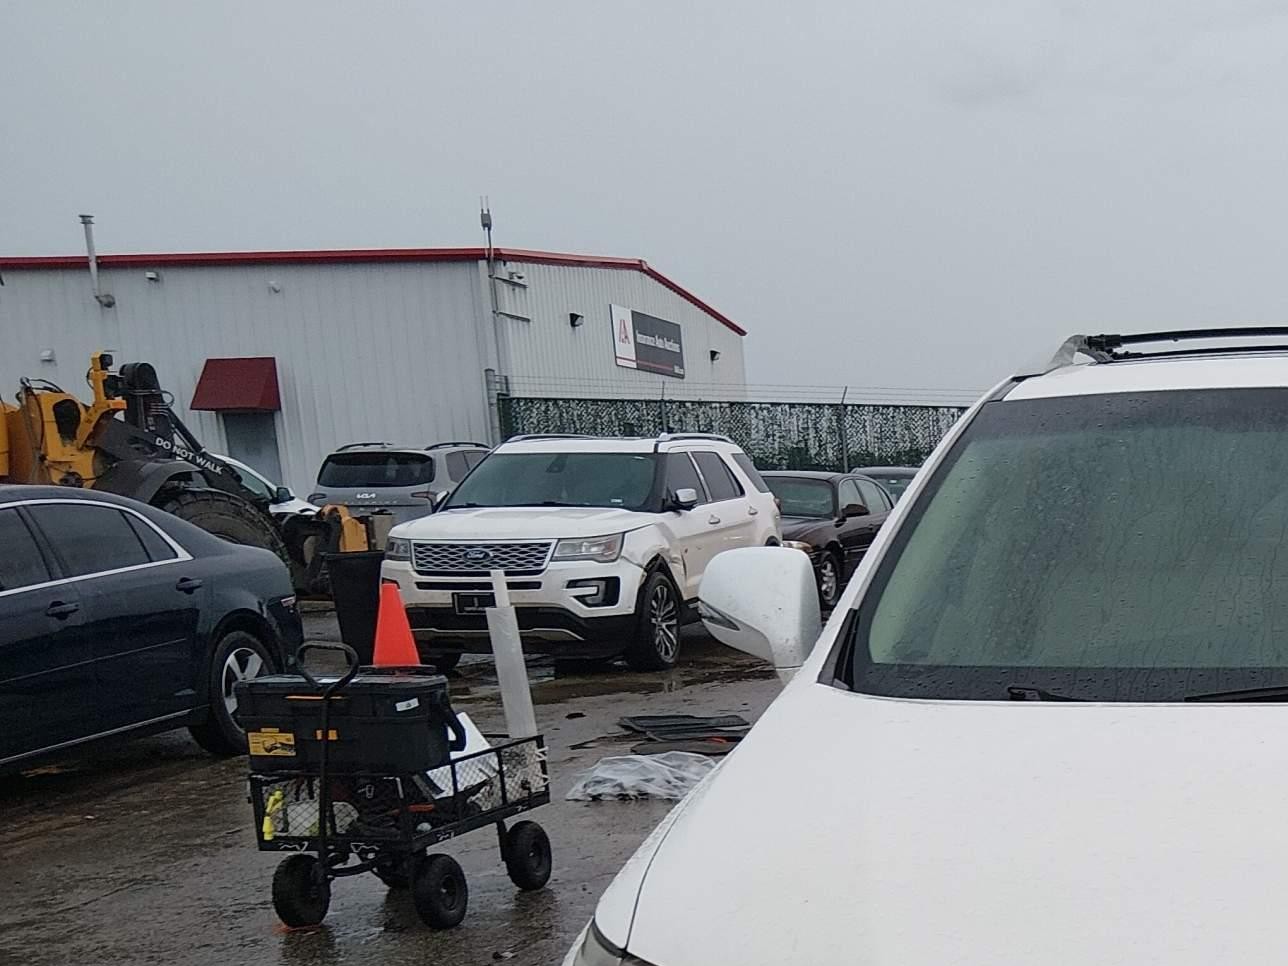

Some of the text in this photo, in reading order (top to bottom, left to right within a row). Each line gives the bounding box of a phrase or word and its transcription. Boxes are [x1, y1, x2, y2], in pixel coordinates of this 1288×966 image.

[155, 437, 222, 474] DO NOT WALK
